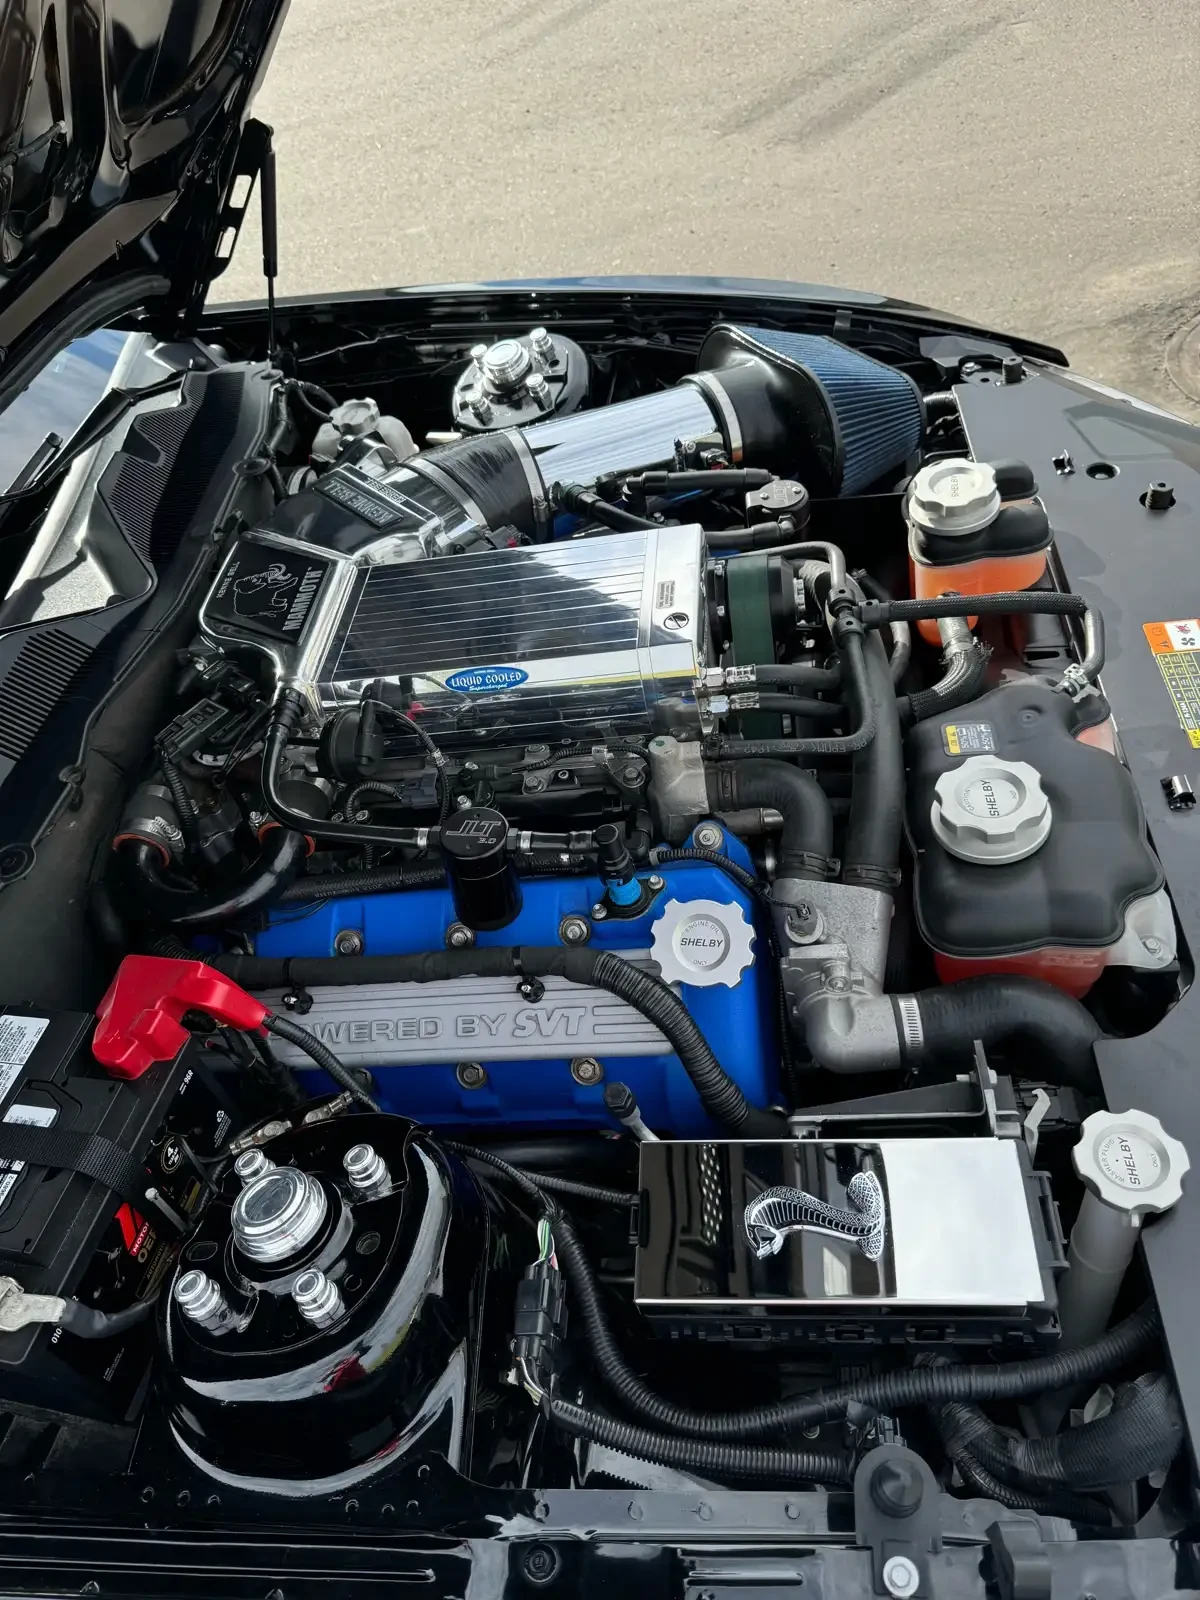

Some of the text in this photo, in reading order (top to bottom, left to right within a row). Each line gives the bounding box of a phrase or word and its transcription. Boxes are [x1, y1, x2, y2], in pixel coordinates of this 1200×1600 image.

[216, 561, 240, 598] KENNE BELL
[282, 569, 323, 631] MAMMOTH
[450, 672, 522, 688] LIQUID COOLED
[469, 682, 508, 692] Supercharged
[963, 789, 975, 811] CAUTION
[980, 780, 1000, 816] SHELBY
[445, 820, 502, 837] JLT
[685, 921, 720, 934] ENGINE OIL
[680, 937, 724, 948] SHELBY
[299, 1007, 587, 1044] WERED BY SVT
[1101, 1138, 1125, 1183] WASHER FLUID
[1118, 1136, 1141, 1185] SHELBY
